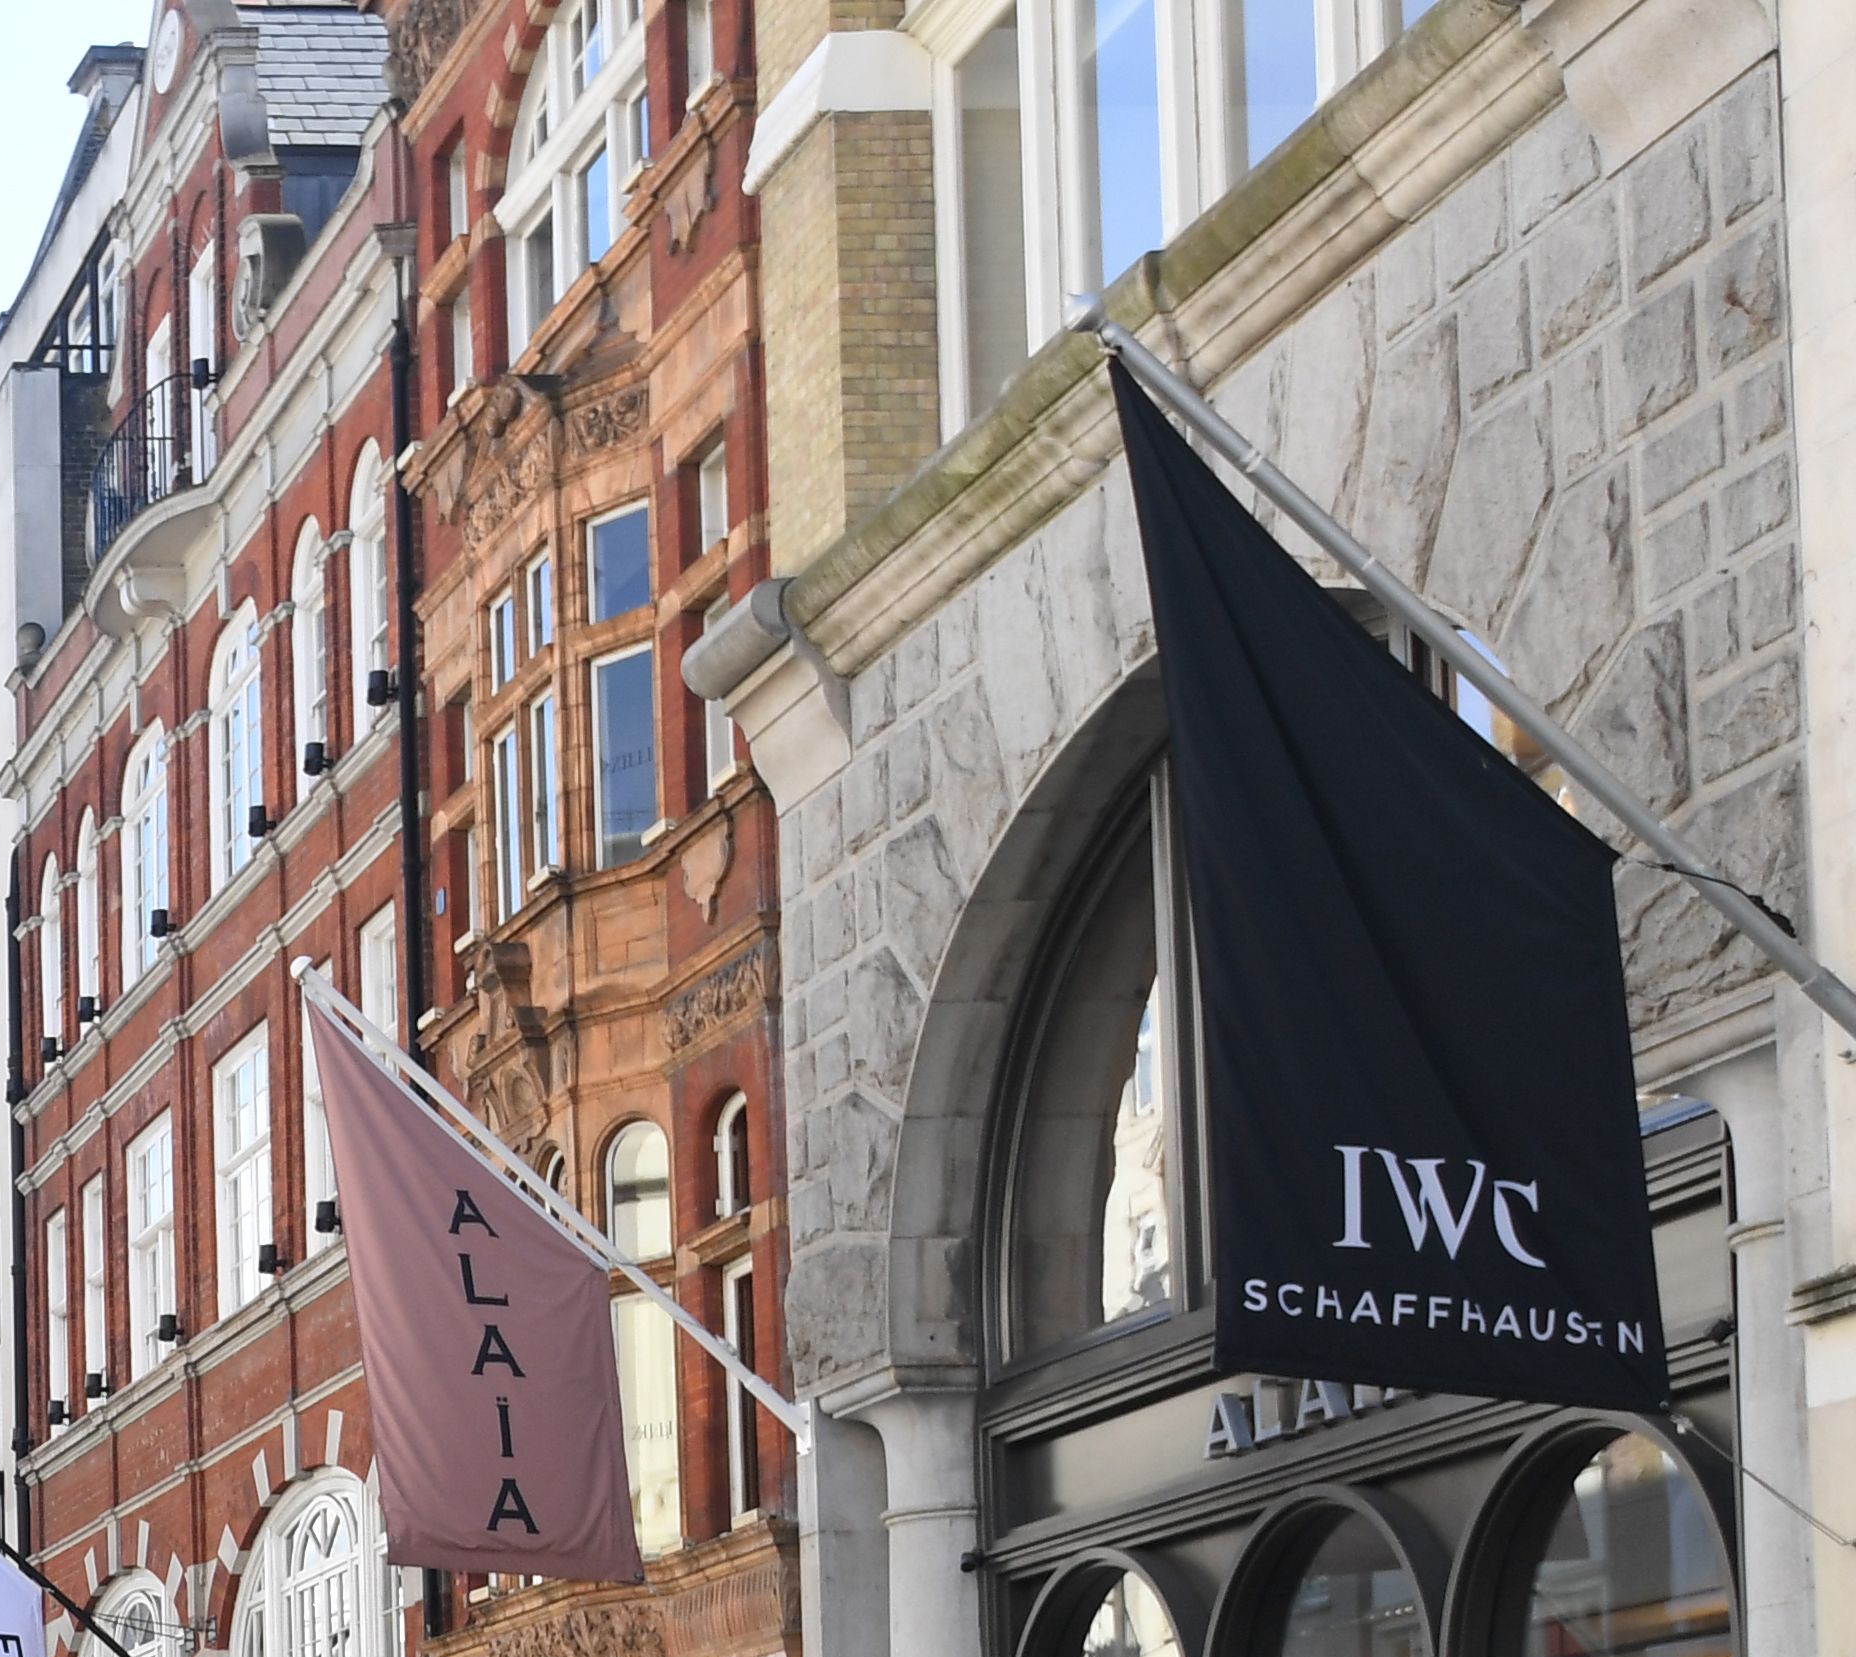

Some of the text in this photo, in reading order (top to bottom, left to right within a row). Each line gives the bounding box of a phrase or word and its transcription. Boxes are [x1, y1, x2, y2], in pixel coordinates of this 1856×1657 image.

[1331, 1144, 1548, 1269] IWC
[448, 1189, 540, 1535] ALAÏA
[1203, 1378, 1428, 1459] ALA
